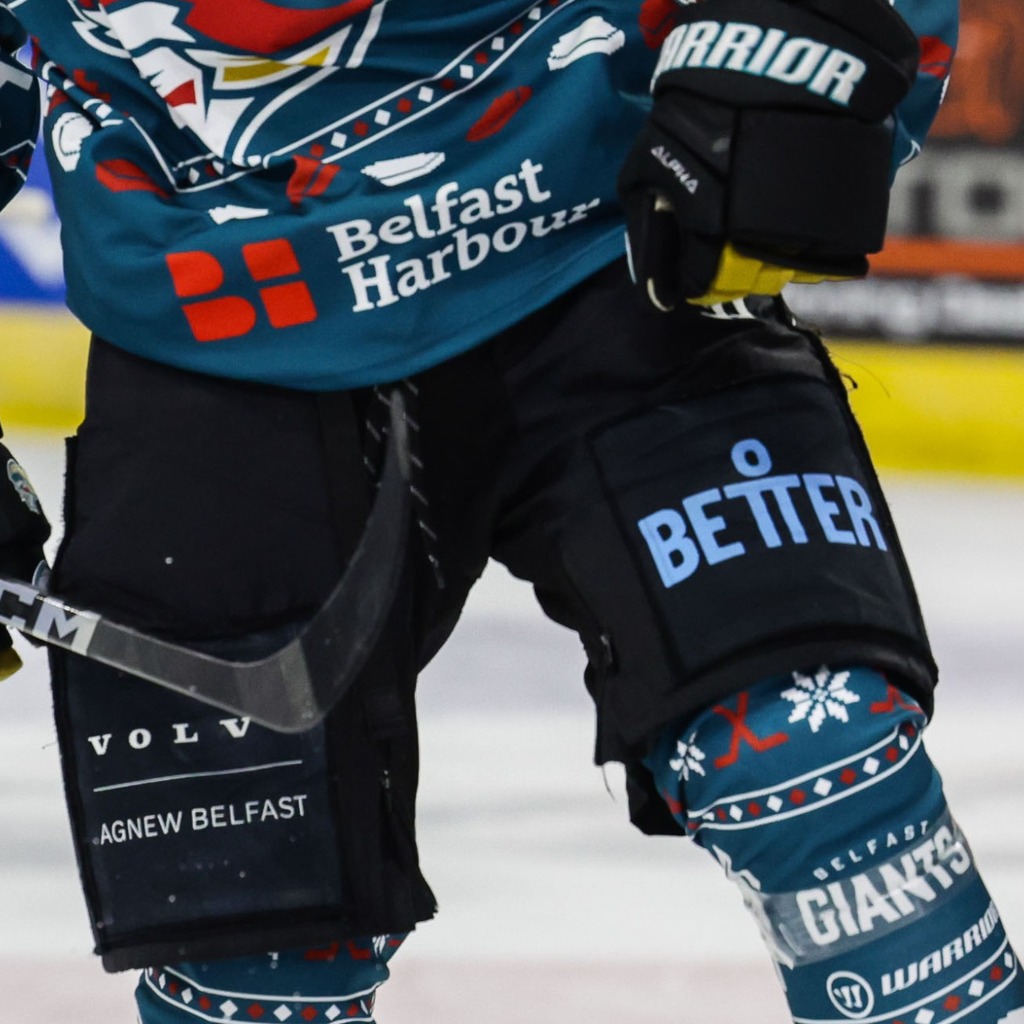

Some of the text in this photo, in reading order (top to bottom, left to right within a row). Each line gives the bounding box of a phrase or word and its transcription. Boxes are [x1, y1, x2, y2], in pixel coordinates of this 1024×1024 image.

[326, 158, 551, 263] Belfast
[651, 145, 699, 194] ALPHA
[341, 197, 601, 313] Harbour
[638, 474, 888, 588] BETTER
[88, 716, 252, 756] VOLV
[99, 794, 308, 845] AGNEW BELFAST
[812, 820, 929, 881] BELFAST
[796, 825, 972, 947] GIANTS
